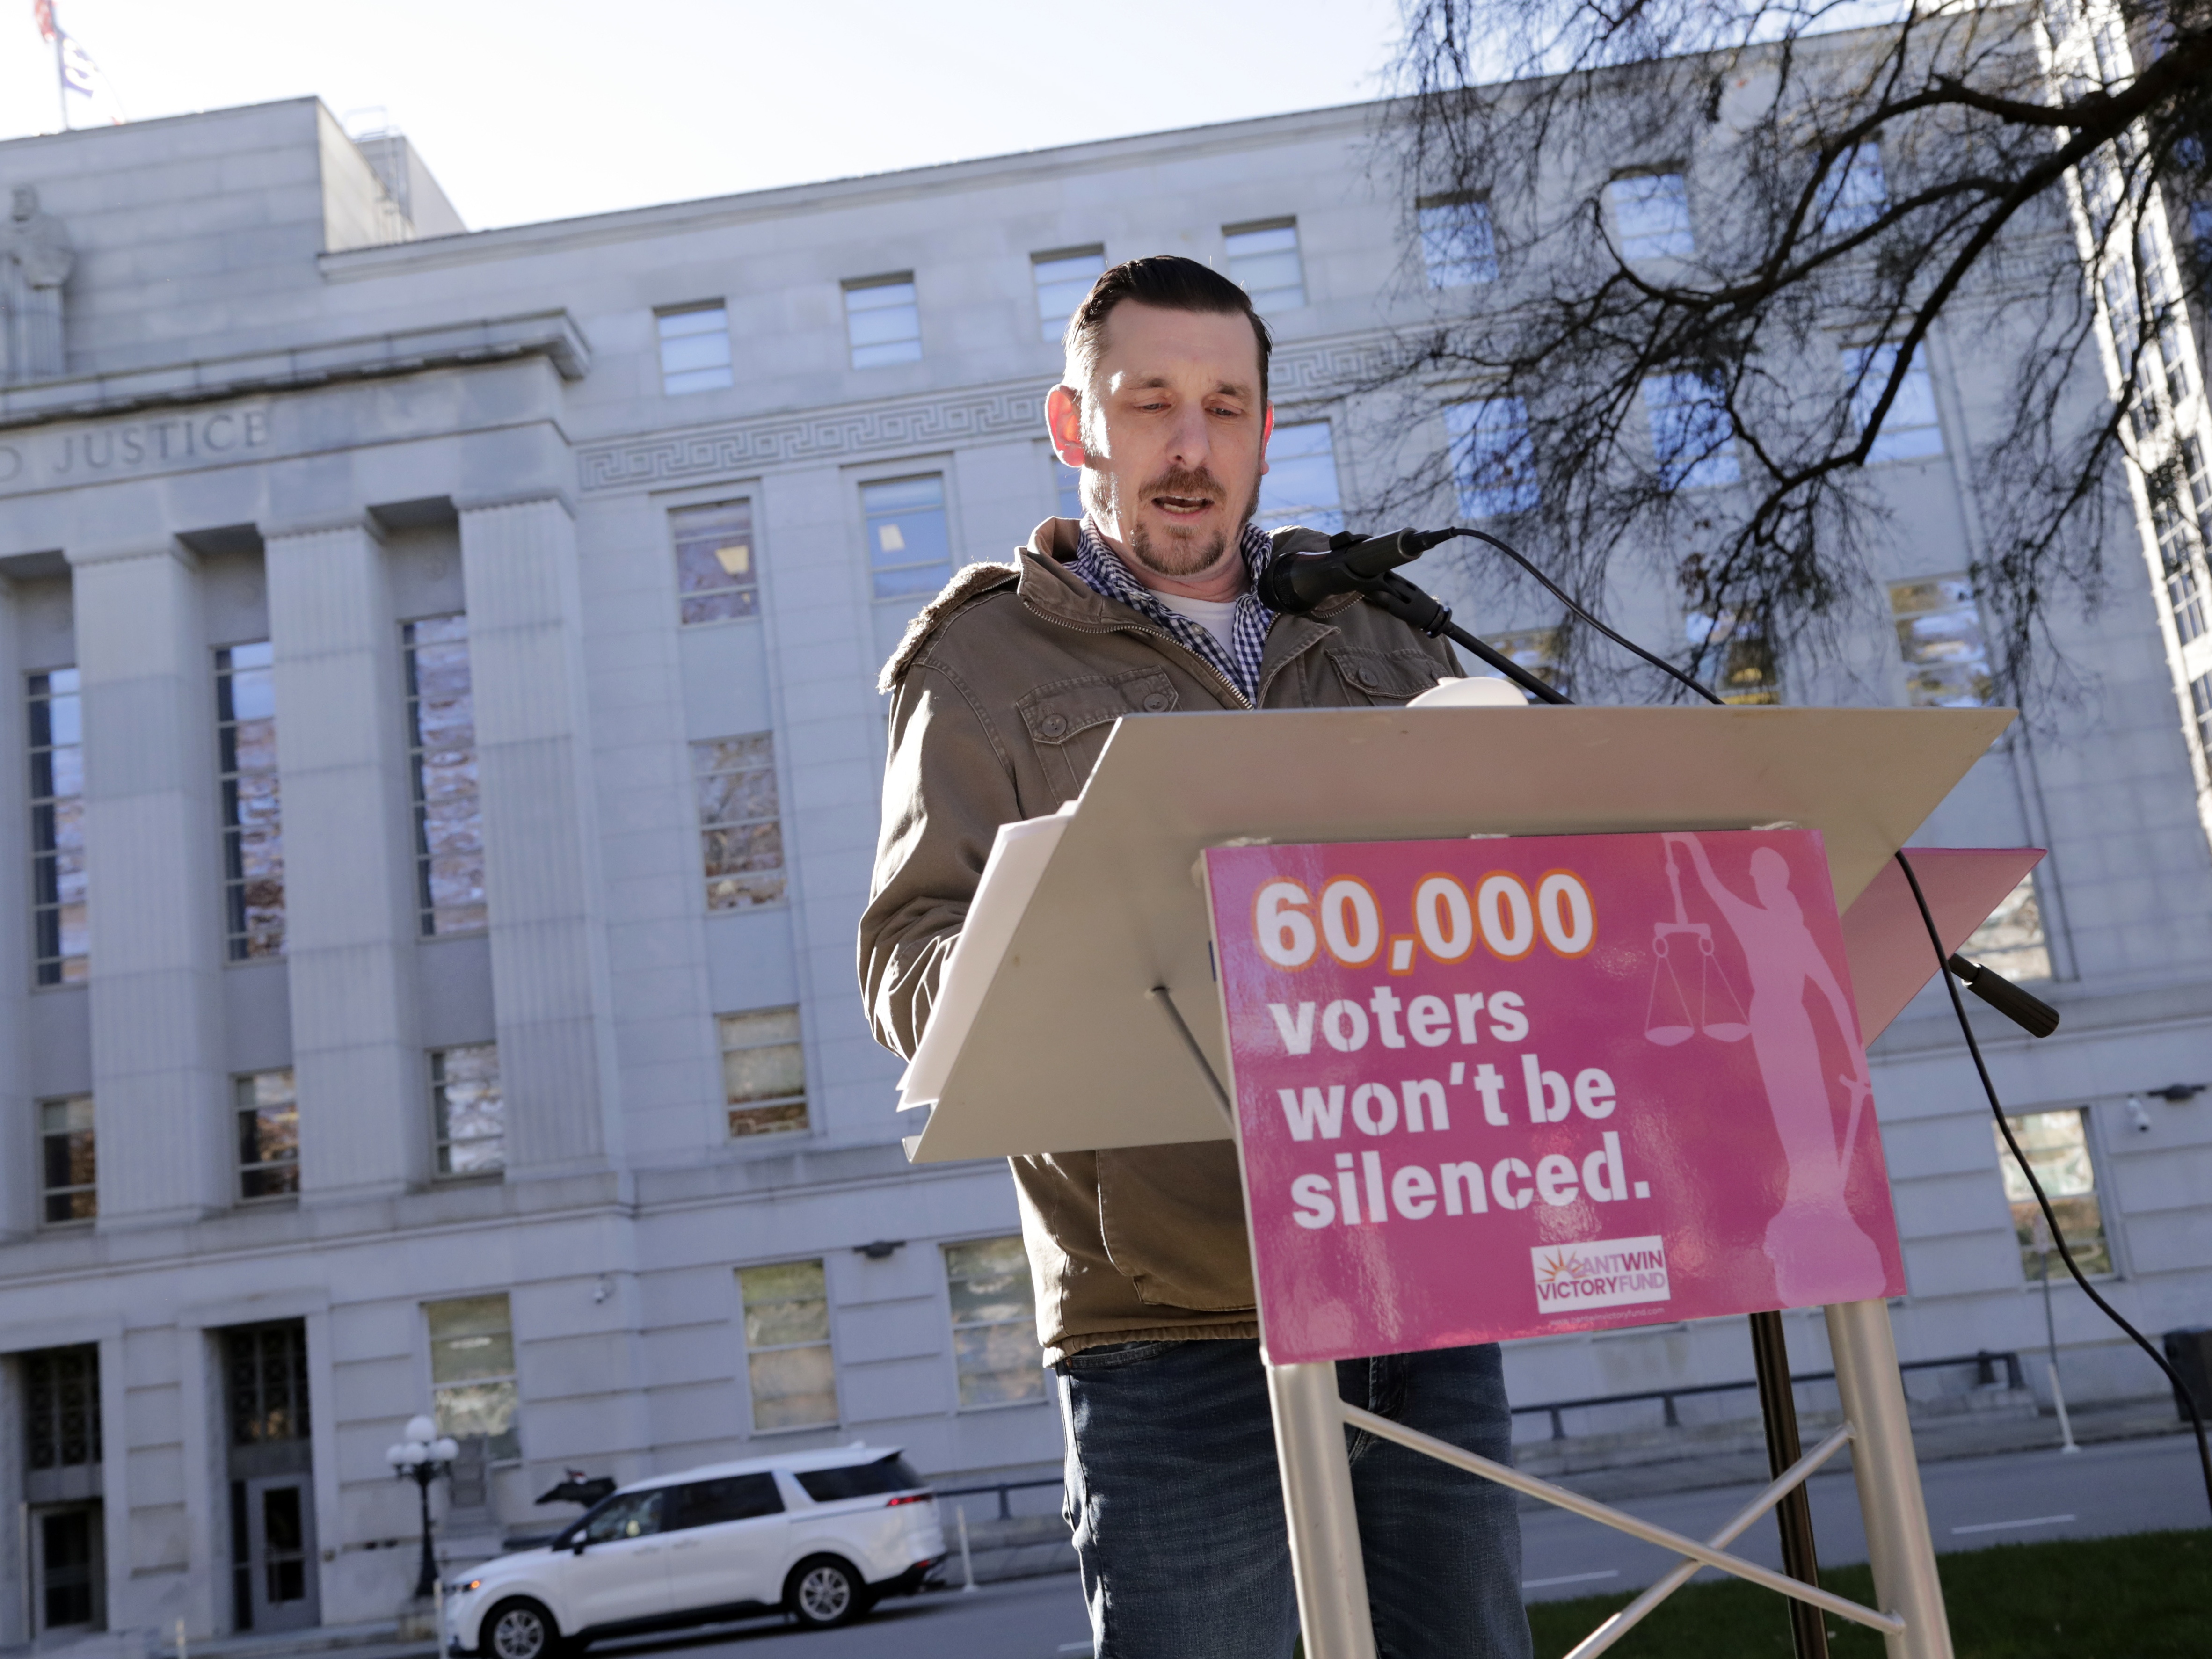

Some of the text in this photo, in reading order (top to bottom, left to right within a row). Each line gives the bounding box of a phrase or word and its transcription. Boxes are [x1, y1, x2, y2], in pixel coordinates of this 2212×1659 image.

[52, 409, 269, 474] JUSTICE
[1252, 868, 1597, 976] 60,000
[1268, 986, 1529, 1055] voters
[1277, 1054, 1616, 1142] won't be
[1291, 1131, 1650, 1229] silenced.
